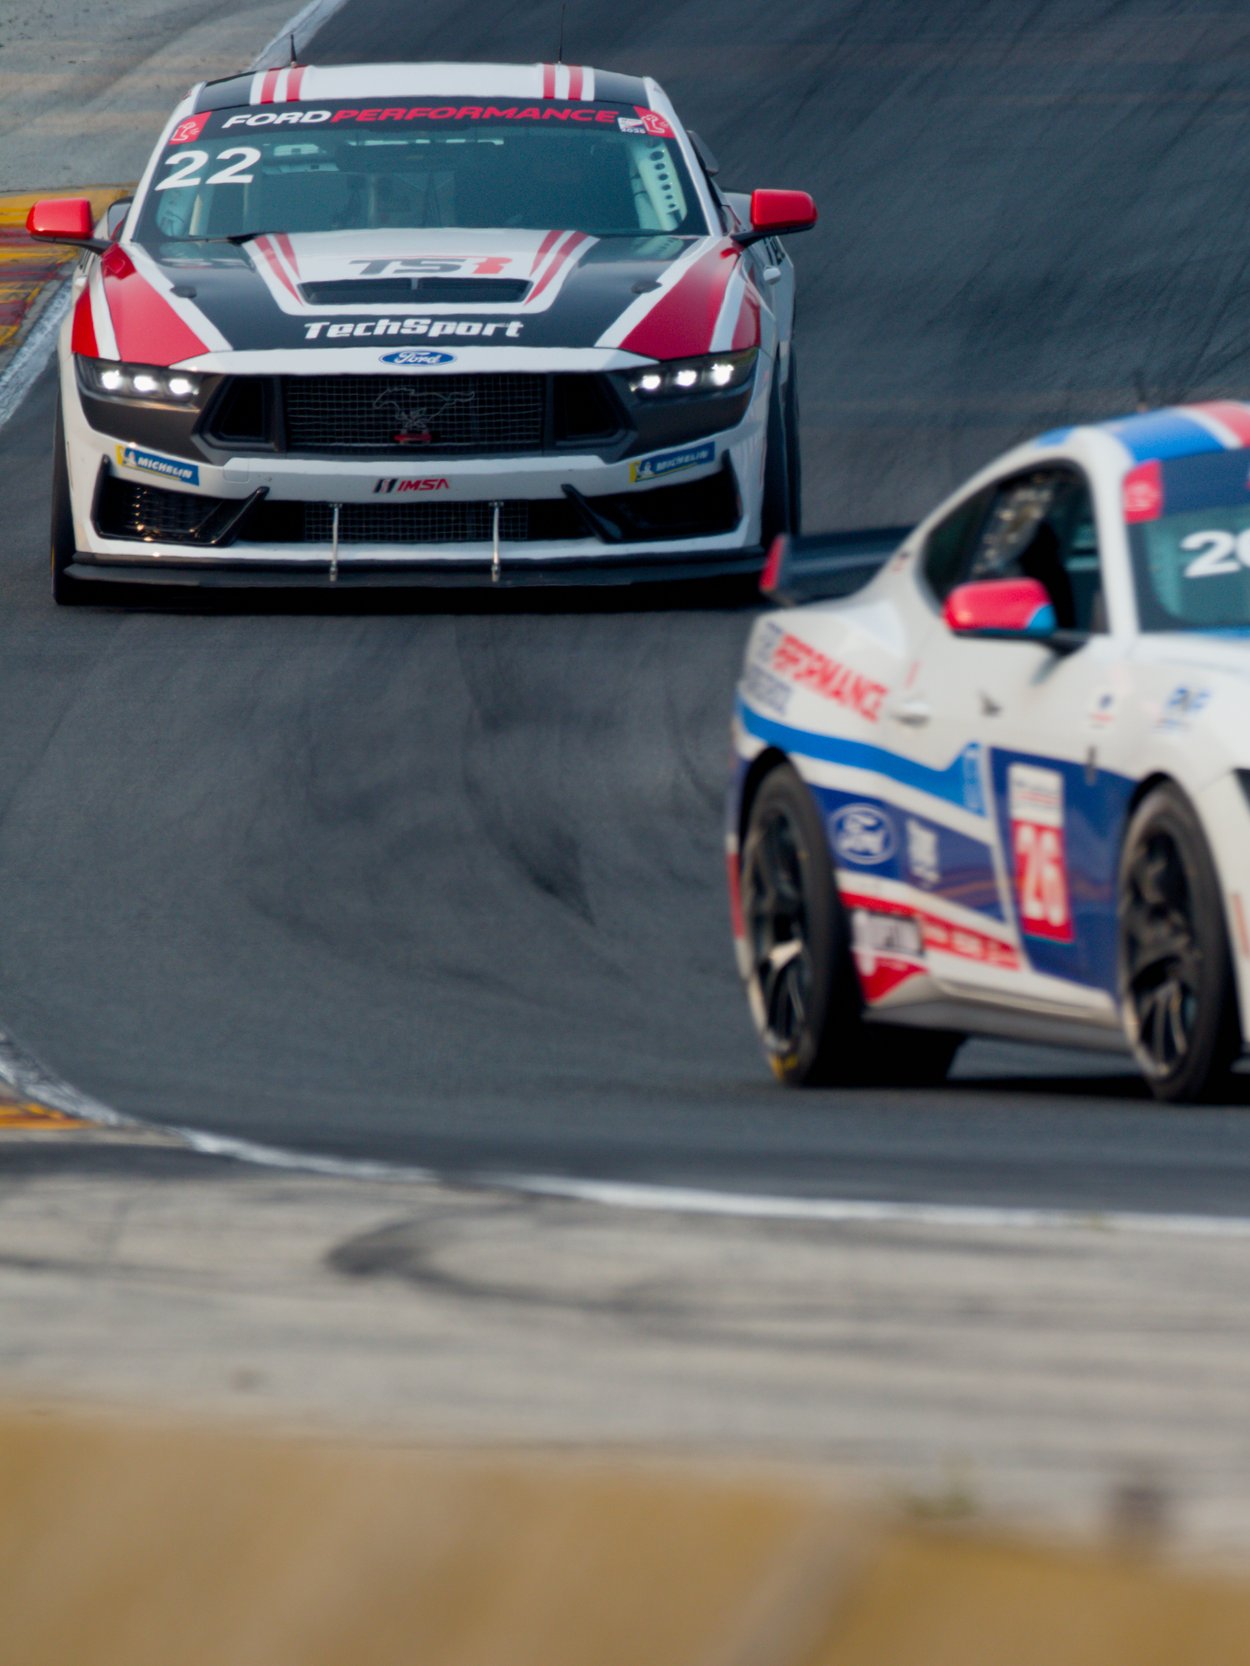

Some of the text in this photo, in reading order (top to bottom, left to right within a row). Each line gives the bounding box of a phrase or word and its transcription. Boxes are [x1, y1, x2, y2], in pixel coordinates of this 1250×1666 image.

[221, 106, 619, 129] FORD PERFORMANCE
[154, 147, 261, 191] 22
[303, 318, 524, 340] TechSport
[394, 351, 441, 364] Ford
[137, 457, 193, 479] MICHELIN
[396, 478, 449, 493] IMSA
[1016, 824, 1066, 927] 26
